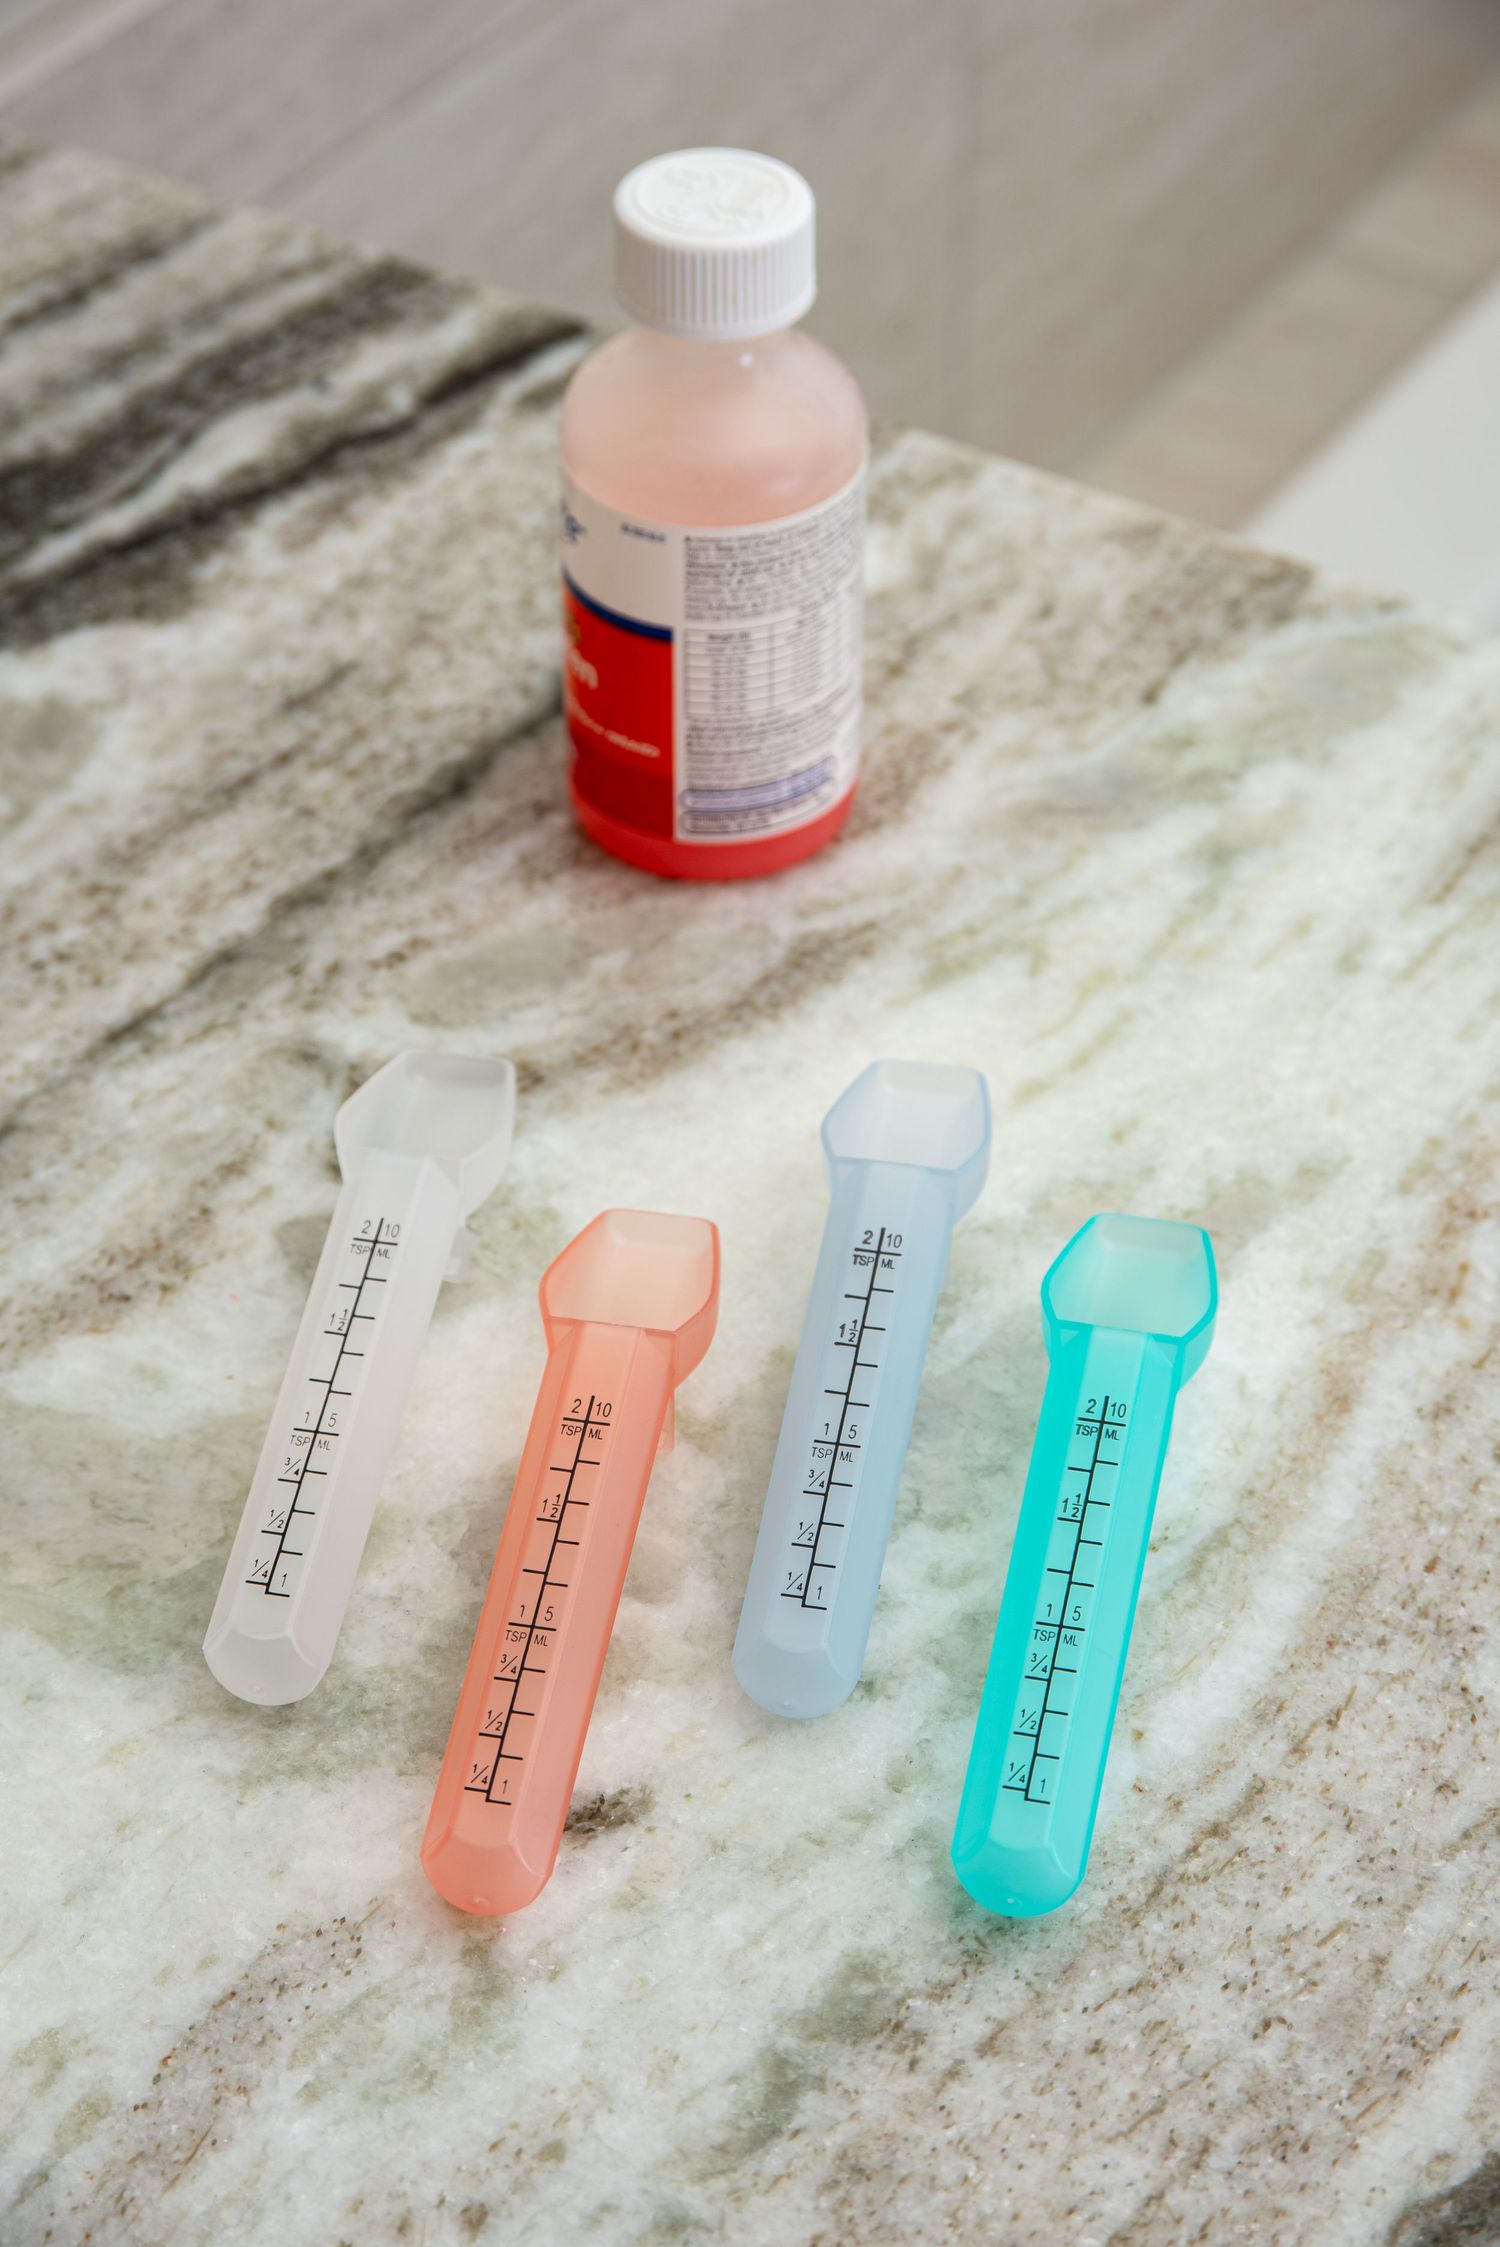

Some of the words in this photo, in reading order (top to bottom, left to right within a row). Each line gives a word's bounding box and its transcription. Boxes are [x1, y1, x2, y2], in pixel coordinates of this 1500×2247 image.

[362, 1220, 371, 1234] 2
[385, 1223, 400, 1238] 10
[862, 1230, 873, 1245] 2
[887, 1233, 902, 1248] 10
[350, 1243, 372, 1255] TSP
[376, 1248, 390, 1259] ML
[852, 1254, 875, 1267] TSP
[881, 1258, 895, 1269] ML
[571, 1398, 581, 1413] 2
[596, 1402, 612, 1418] 10
[1086, 1399, 1097, 1414] 2
[1110, 1402, 1127, 1418] 10
[304, 1412, 310, 1423] 1
[328, 1413, 338, 1427] 5
[560, 1424, 582, 1436] TSP
[588, 1428, 602, 1440] ML
[824, 1423, 829, 1436] 1
[848, 1424, 857, 1439] 5
[1075, 1424, 1098, 1437] TSP
[1105, 1429, 1119, 1440] ML
[290, 1434, 311, 1446] TSP
[317, 1439, 331, 1450] ML
[811, 1447, 832, 1459] TSP
[839, 1451, 853, 1463] ML
[281, 1573, 287, 1588] 1
[817, 1586, 823, 1600] 1
[520, 1605, 525, 1618] 1
[544, 1606, 554, 1621] 5
[1047, 1603, 1052, 1617] 1
[1072, 1606, 1082, 1622] 5
[505, 1630, 527, 1643] TSP
[534, 1634, 548, 1646] ML
[1033, 1629, 1056, 1642] TSP
[1063, 1633, 1078, 1646] ML
[502, 1780, 508, 1794] 1
[1040, 1778, 1046, 1793] 1
